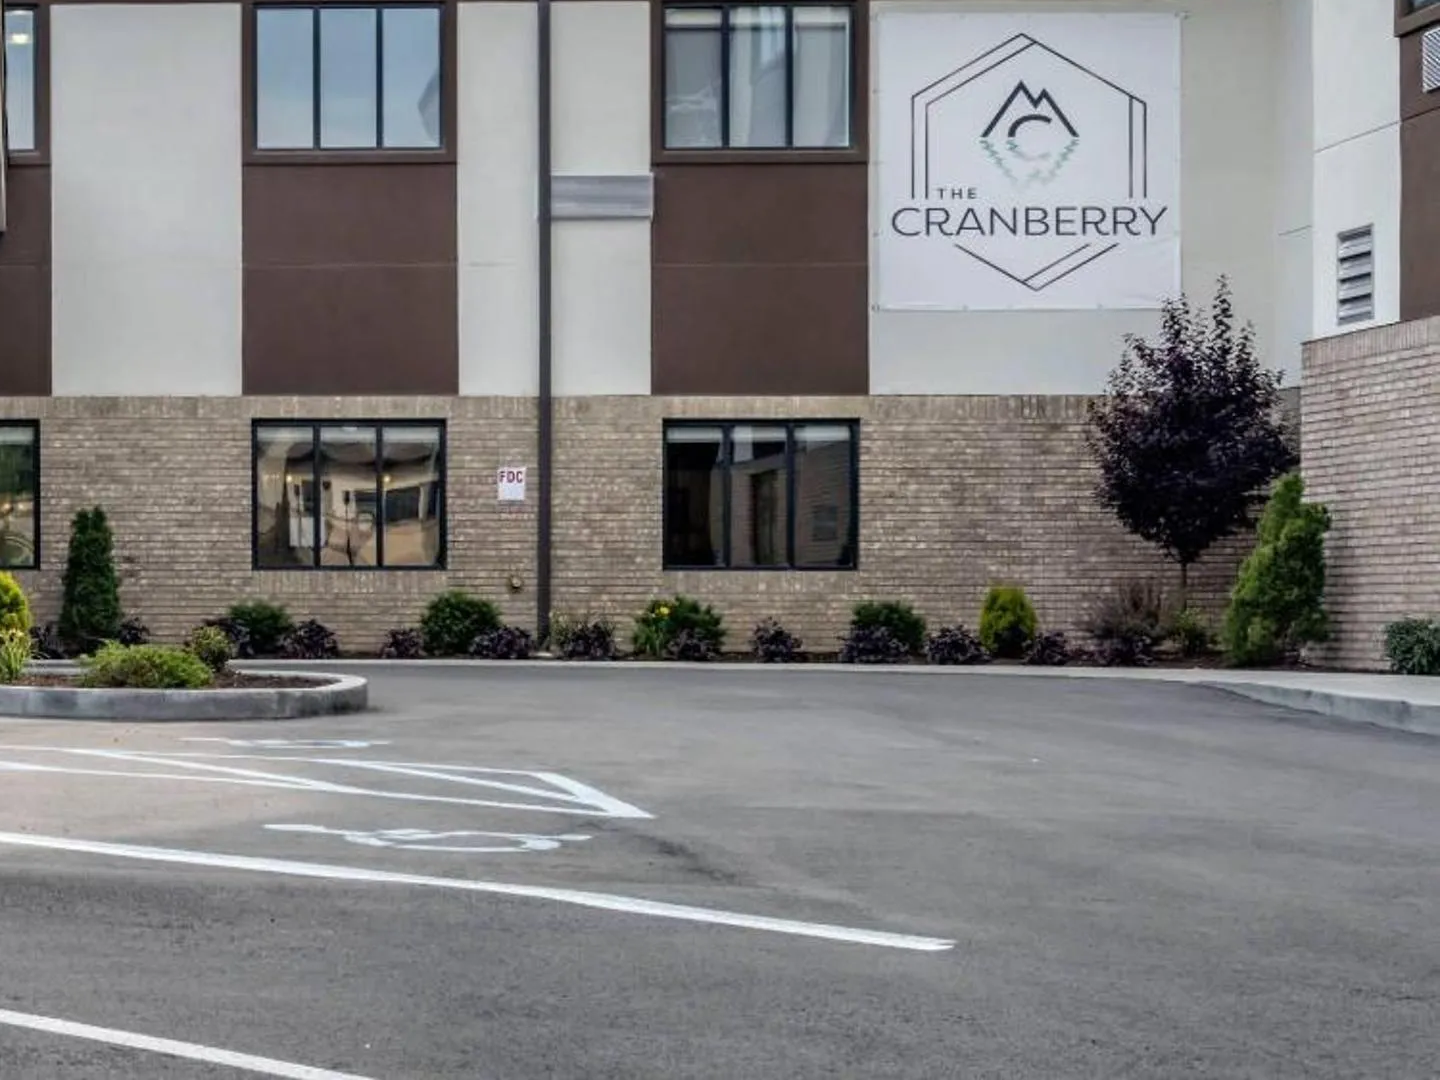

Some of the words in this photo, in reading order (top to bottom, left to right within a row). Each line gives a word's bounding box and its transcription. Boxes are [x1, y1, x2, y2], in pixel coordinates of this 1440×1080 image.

[937, 188, 977, 200] THE
[891, 206, 1168, 236] CRANBERRY
[499, 470, 523, 483] FDC
